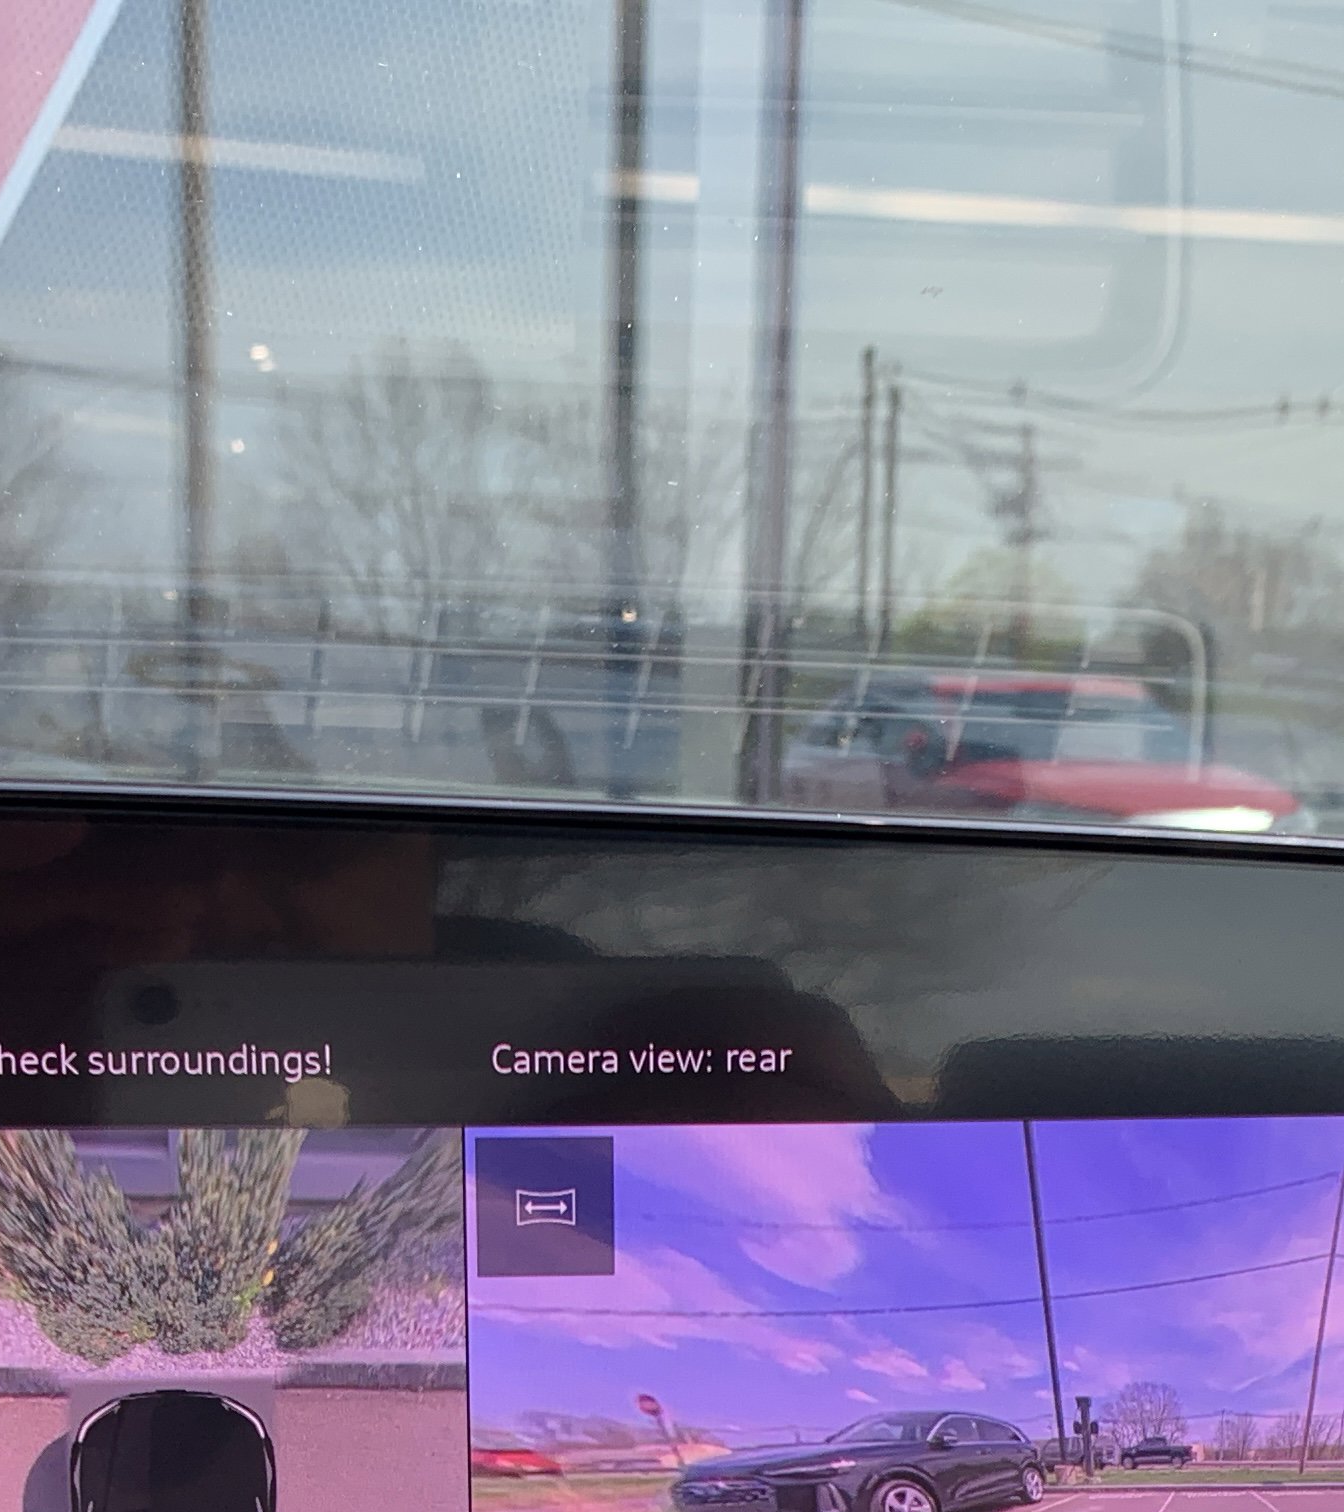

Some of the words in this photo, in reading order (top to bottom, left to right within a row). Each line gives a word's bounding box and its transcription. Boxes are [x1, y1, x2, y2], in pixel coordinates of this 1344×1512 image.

[88, 1043, 332, 1083] surroundings!
[492, 1042, 619, 1075] Camera
[629, 1042, 713, 1074] view:
[726, 1049, 794, 1073] rear
